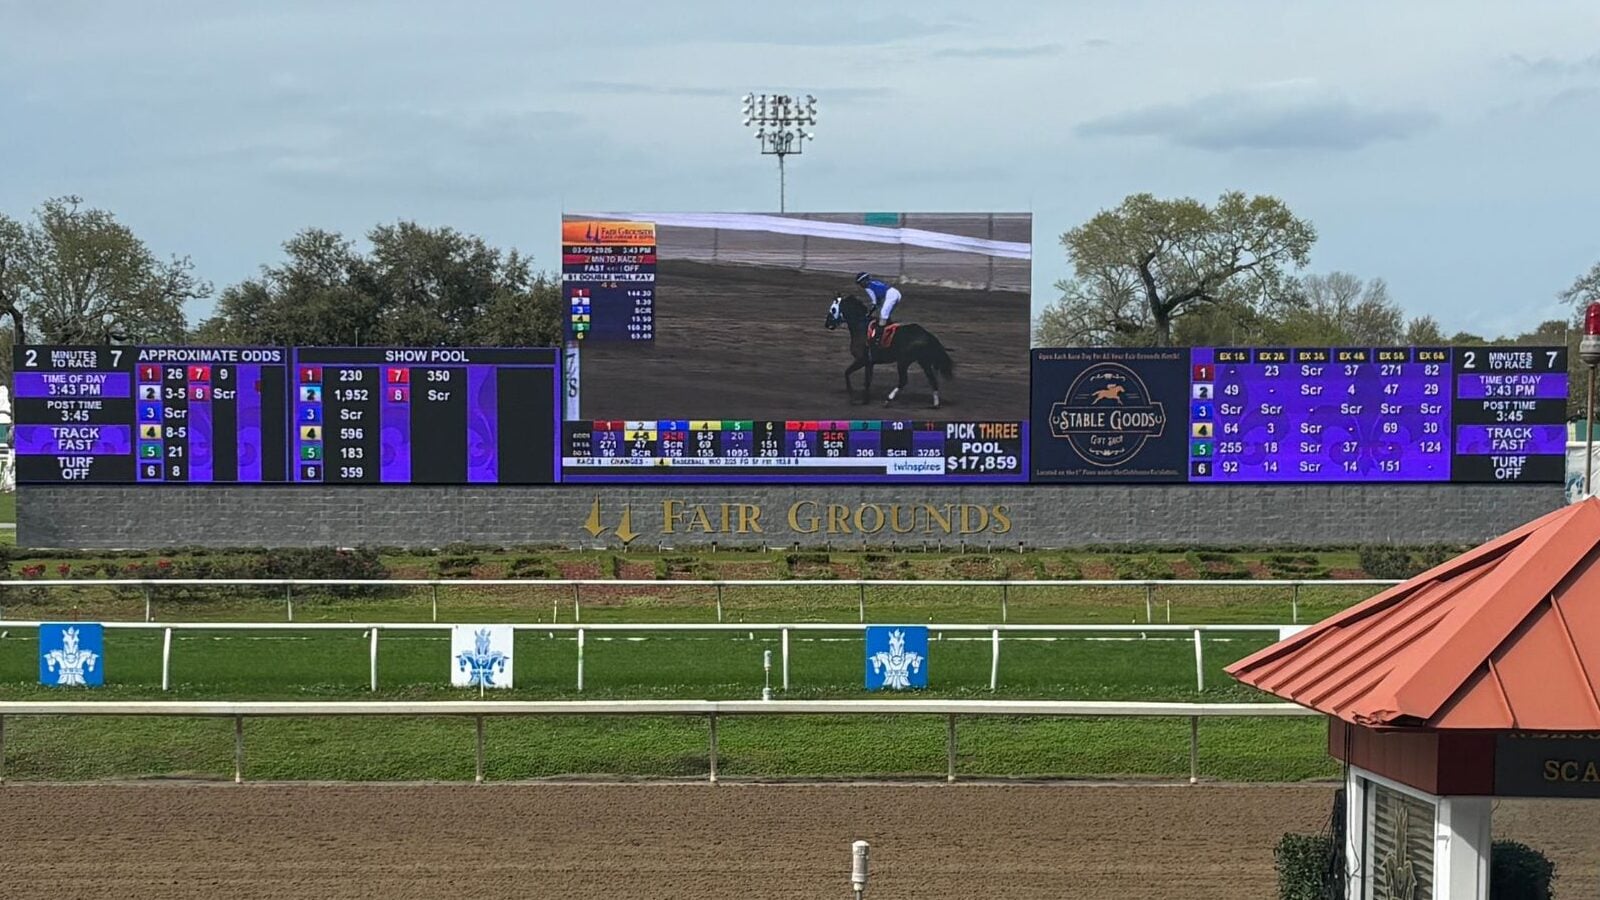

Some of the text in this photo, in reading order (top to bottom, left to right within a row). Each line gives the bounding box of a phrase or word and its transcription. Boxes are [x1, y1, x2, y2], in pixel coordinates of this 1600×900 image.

[25, 350, 38, 367] 2
[51, 351, 97, 360] MINUTES
[110, 350, 123, 367] 7
[139, 350, 281, 361] APPROXIMATE ODDS
[385, 350, 470, 362] SHOW POOL
[1463, 352, 1475, 368] 2
[1488, 352, 1532, 361] MINUTES
[1545, 351, 1557, 368] 7
[52, 360, 97, 368] TO RACE
[1490, 361, 1532, 369] TO RACE
[146, 368, 228, 380] 1 26 7 9
[306, 370, 450, 381] 1 230 7 350
[1200, 365, 1439, 378] 1 23 Scr 37 271 82
[42, 375, 107, 383] TIME OF DAY
[1479, 376, 1541, 384] TIME OF DAY
[49, 384, 101, 395] 3:43 PM
[146, 387, 236, 399] 2 3-5 8 Scr
[1200, 384, 1439, 398] 2 49 Scr 4 47 29
[1485, 385, 1535, 396] 3:43 PM
[305, 389, 451, 402] 2 1,952 8 Scr
[47, 401, 102, 409] POST TIME
[1199, 403, 1442, 417] 3 Scr Scr Scr Scr Scr
[1483, 401, 1536, 410] POST TIME
[61, 411, 89, 421] 3:45
[146, 407, 187, 418] 3 Scr
[306, 409, 363, 420] 3 Scr
[1496, 411, 1523, 421] 3:45
[892, 421, 903, 430] 10
[946, 423, 1018, 439] PICK THREE
[1198, 422, 1438, 436] 4 64 3 Scr 69 30
[51, 428, 99, 438] TRACK
[146, 426, 186, 438] 4 8-5
[306, 428, 364, 439] 4 596
[1486, 428, 1532, 438] TRACK
[58, 440, 93, 450] FAST
[600, 440, 617, 449] 271
[635, 440, 646, 449] 47
[699, 440, 711, 449] 69
[761, 440, 778, 449] 151
[961, 442, 1003, 453] POOL
[1200, 442, 1441, 456] 5 255 18 Scr 37 124
[1492, 440, 1526, 450] FAST
[147, 446, 182, 457] 5 21
[307, 448, 364, 459] 5 183
[57, 457, 94, 467] TURF
[894, 458, 941, 472] twinspires
[947, 456, 1017, 472] $17,859
[1491, 456, 1526, 467] TURF
[147, 466, 180, 477] 6 8
[307, 467, 364, 478] 6 359
[1198, 461, 1400, 475] 6 92 14 Scr 14 151
[1495, 468, 1522, 479] OFF
[62, 469, 89, 479] OFF
[660, 499, 1013, 534] FAIR GROUNDS
[1543, 760, 1600, 783] SCA
